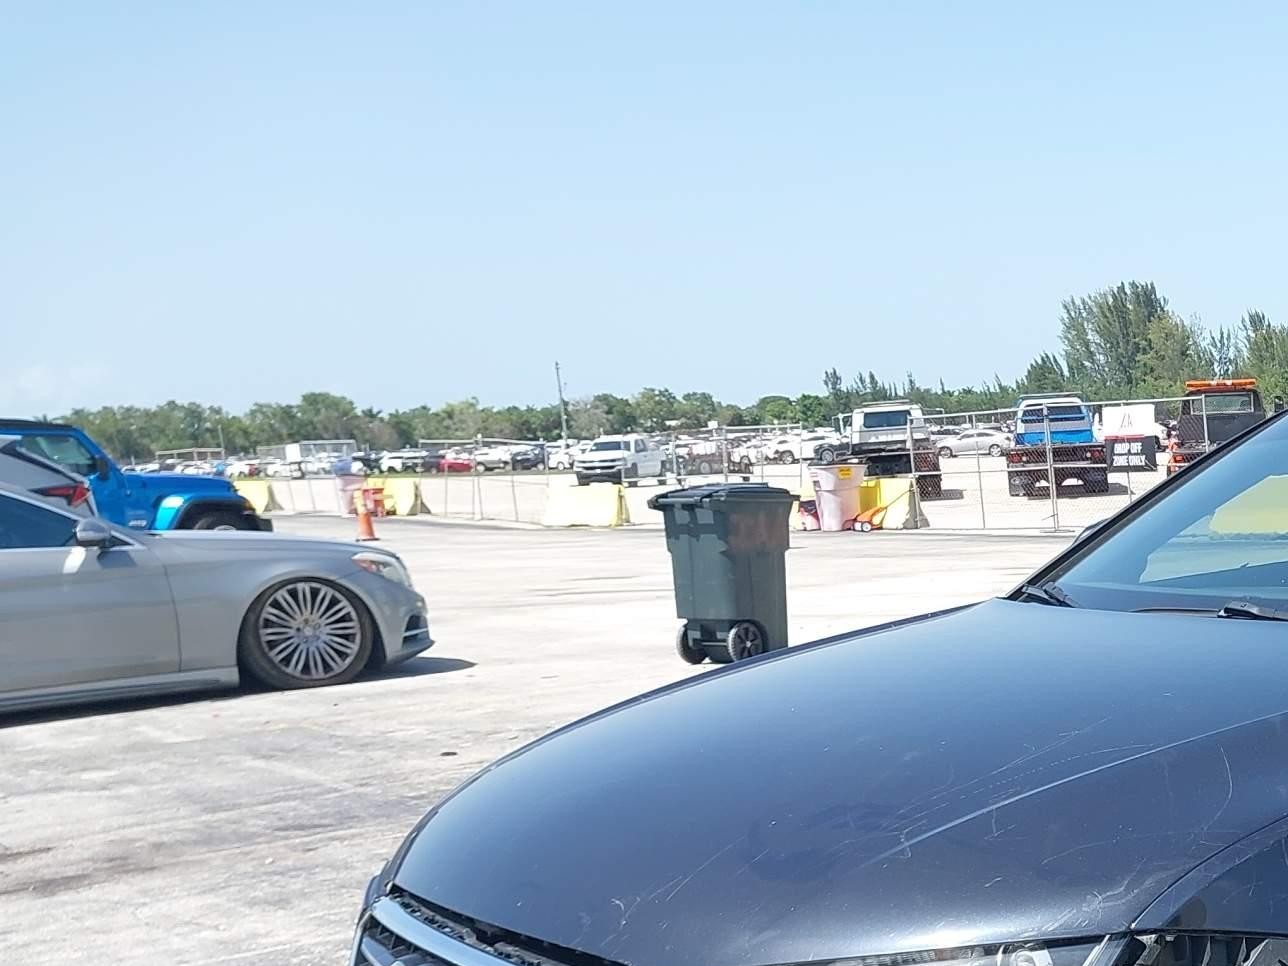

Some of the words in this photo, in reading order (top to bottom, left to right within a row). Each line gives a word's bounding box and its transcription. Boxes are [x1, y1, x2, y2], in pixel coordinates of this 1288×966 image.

[1114, 443, 1129, 454] DROP
[1130, 443, 1142, 453] OFF
[1113, 455, 1128, 466] ZONE
[1129, 455, 1145, 466] ONLY
